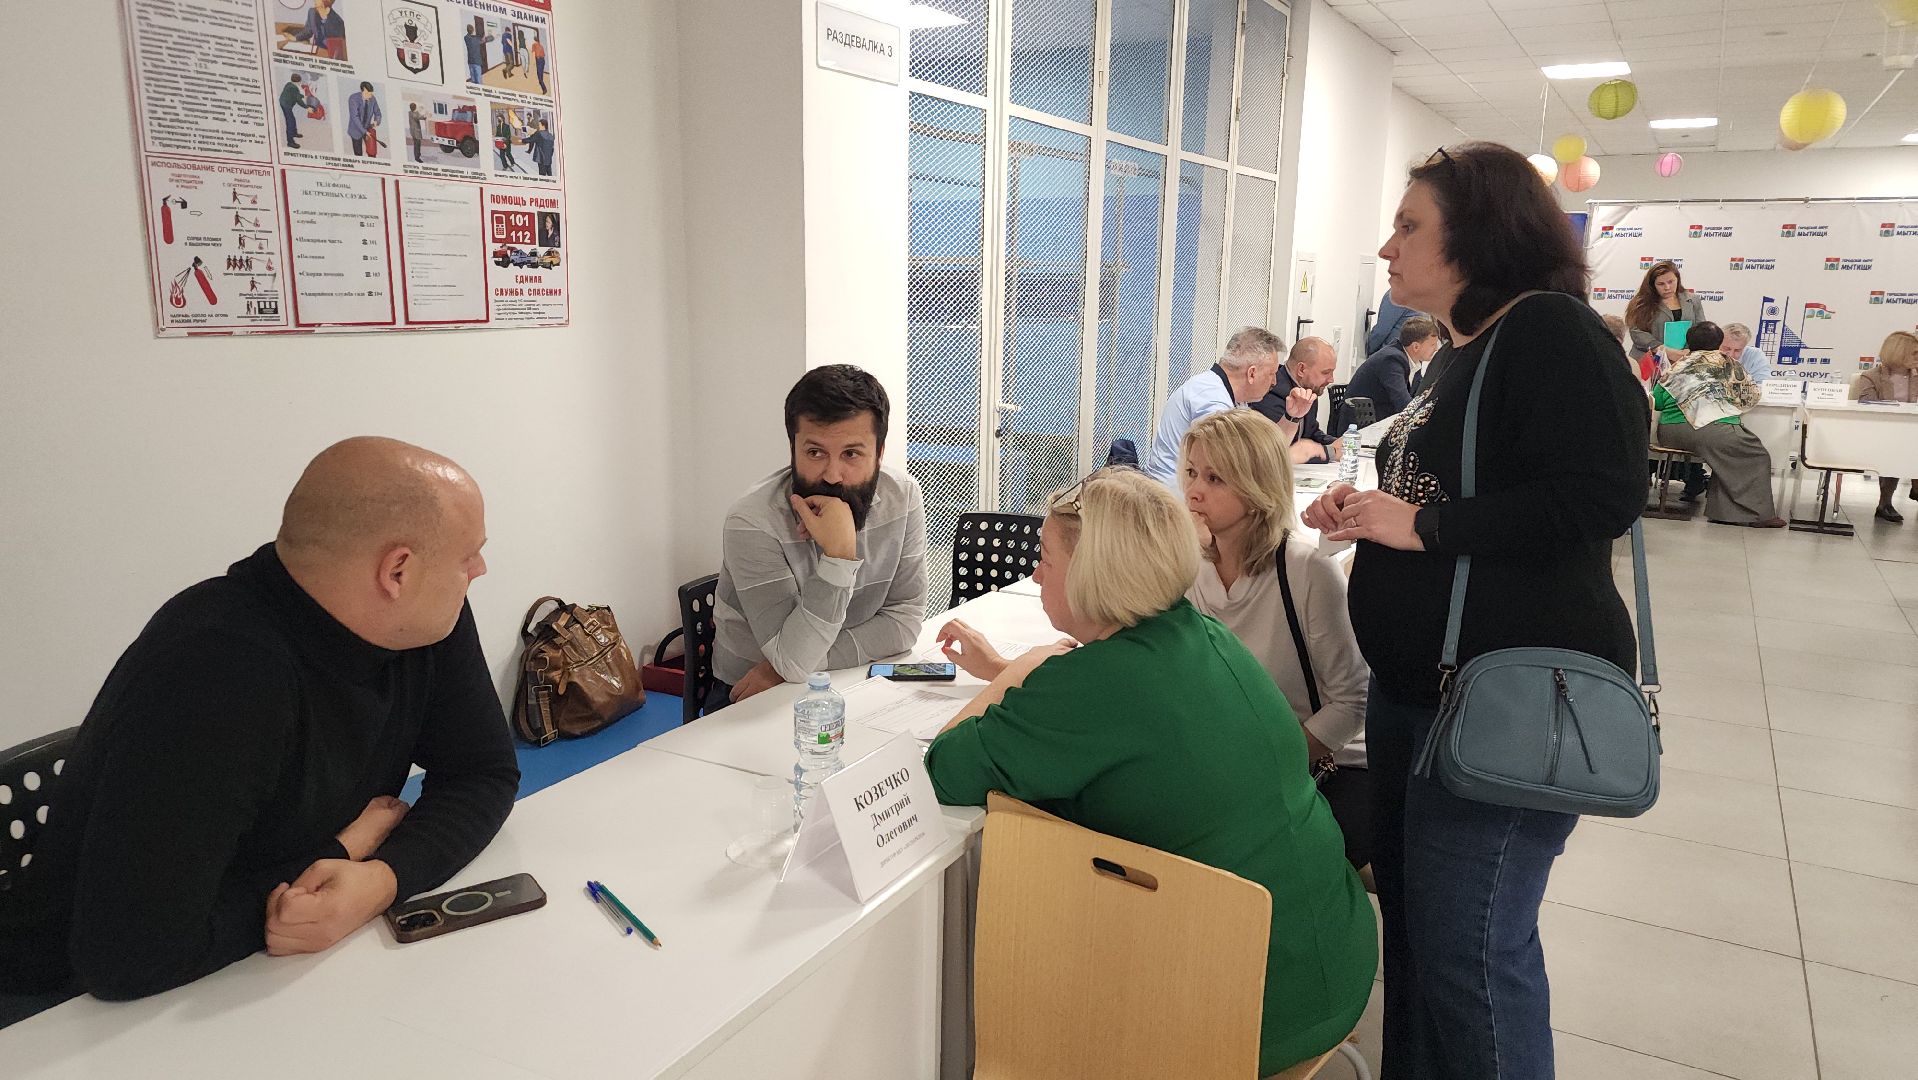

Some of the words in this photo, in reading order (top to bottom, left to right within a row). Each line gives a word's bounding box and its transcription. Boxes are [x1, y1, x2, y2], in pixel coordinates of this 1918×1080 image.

[511, 10, 546, 24] ЗДАНИИ
[827, 28, 885, 55] РАЗДЕВАЛКА
[887, 46, 893, 57] 3
[151, 161, 215, 172] ИСПОЛЬЗОВАНИЕ
[218, 165, 271, 176] ОГНЕТУШИТЕЛЯ
[490, 194, 526, 206] ПОМОЩЬ
[529, 197, 559, 209] РЯДОМ!
[509, 213, 529, 227] 101
[510, 230, 531, 243] 112
[515, 275, 542, 284] ЕДИНАЯ
[494, 288, 524, 297] СЛУЖБА
[527, 288, 562, 297] СПАСЕНИЯ
[853, 767, 911, 812] КОЗЕЧКО
[870, 793, 911, 830] Дмитрий
[876, 814, 918, 848] Олегович
